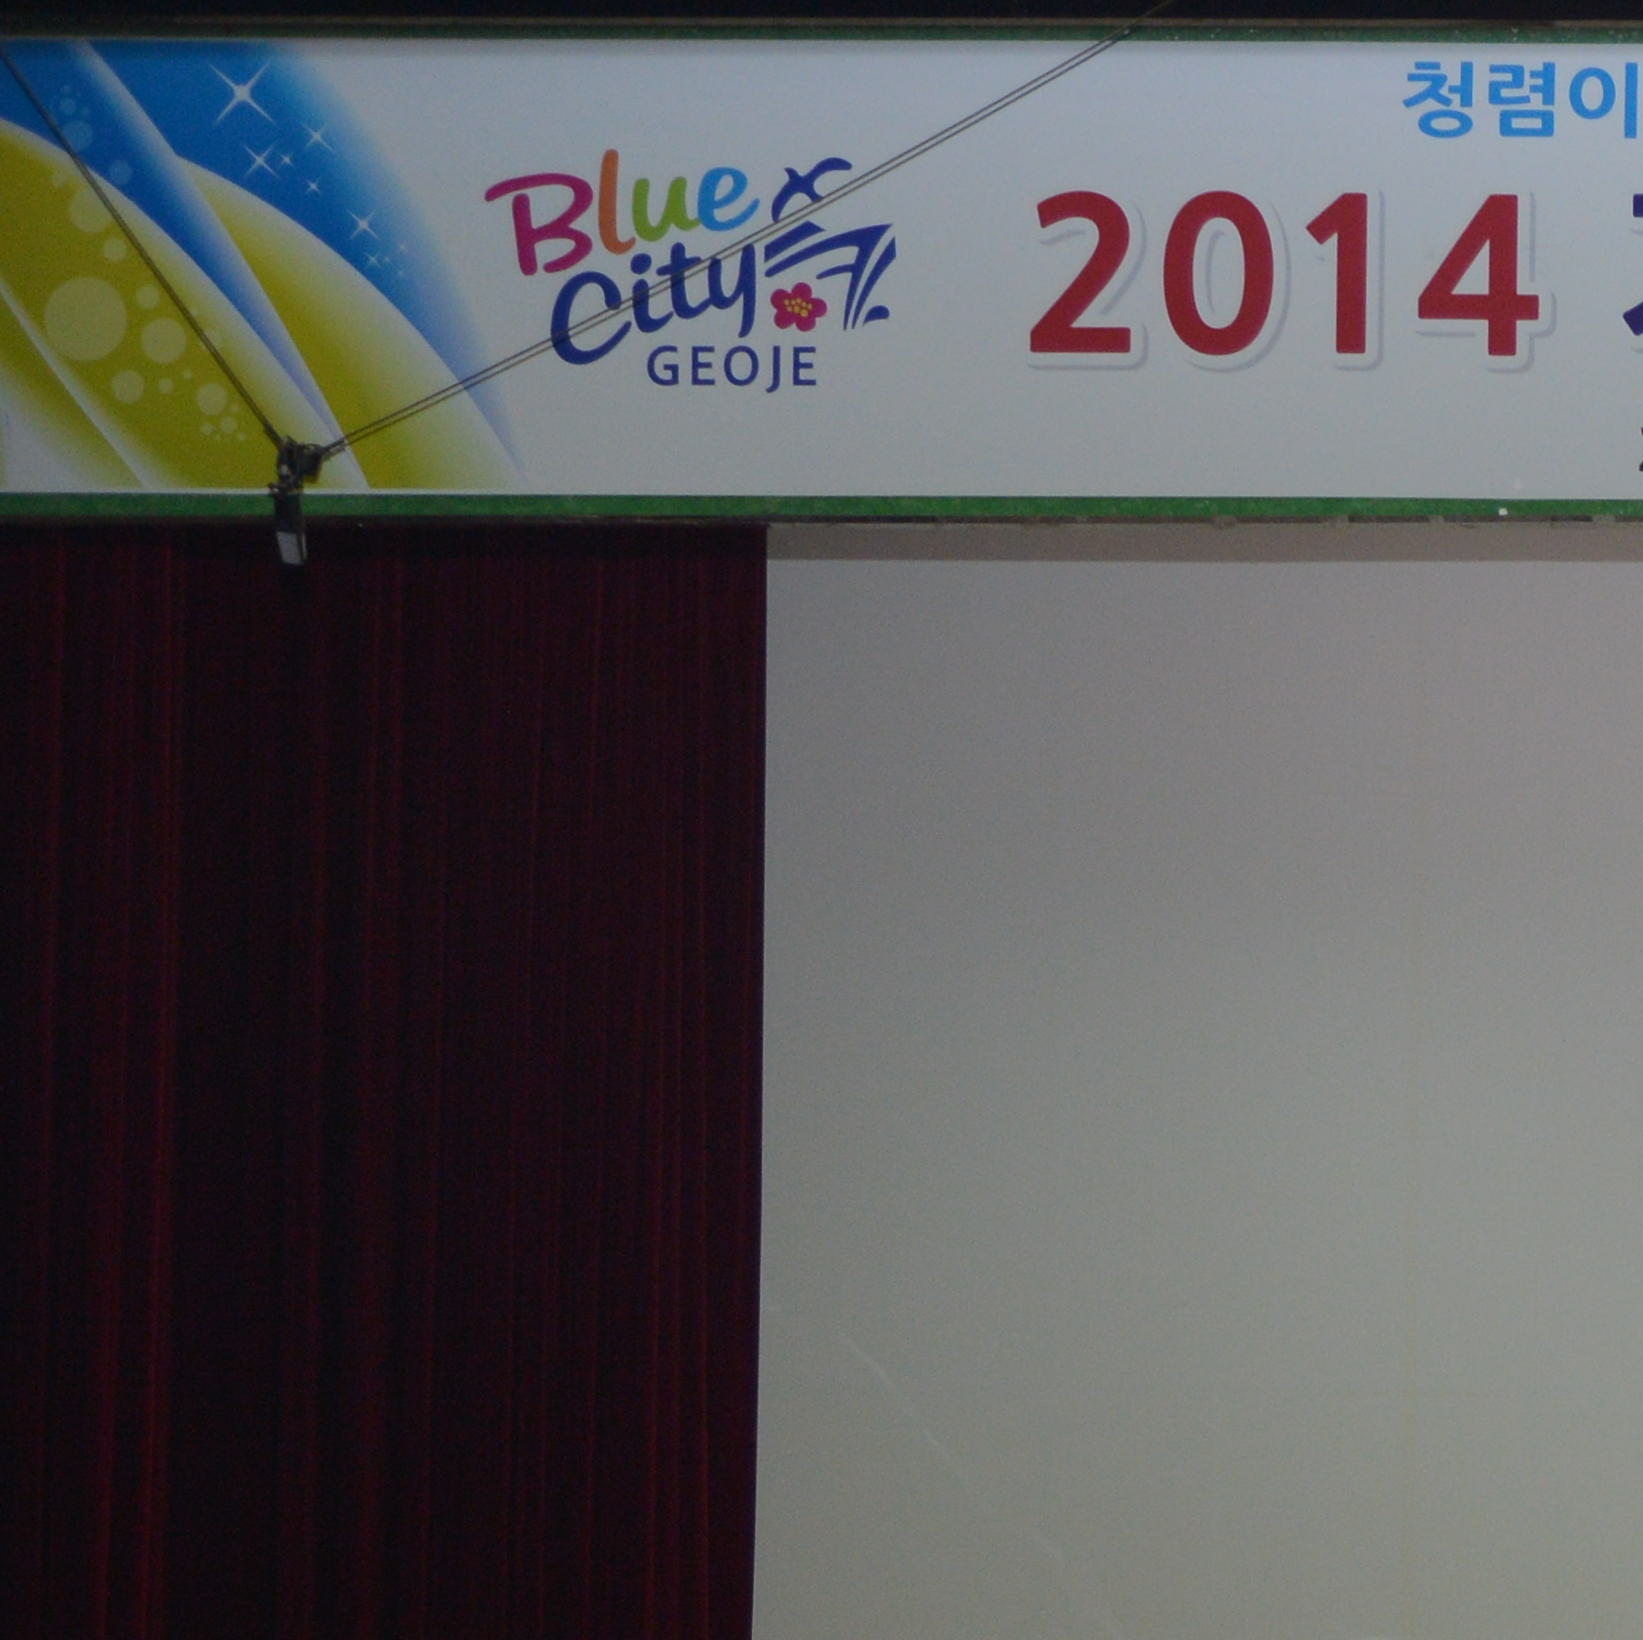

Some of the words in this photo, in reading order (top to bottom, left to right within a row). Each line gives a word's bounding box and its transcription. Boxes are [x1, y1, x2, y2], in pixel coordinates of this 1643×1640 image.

[1403, 61, 1639, 139] 청렴이
[484, 148, 760, 276] Blue
[1031, 191, 1539, 355] 2014
[549, 240, 760, 366] City
[648, 346, 816, 392] GEOJE
